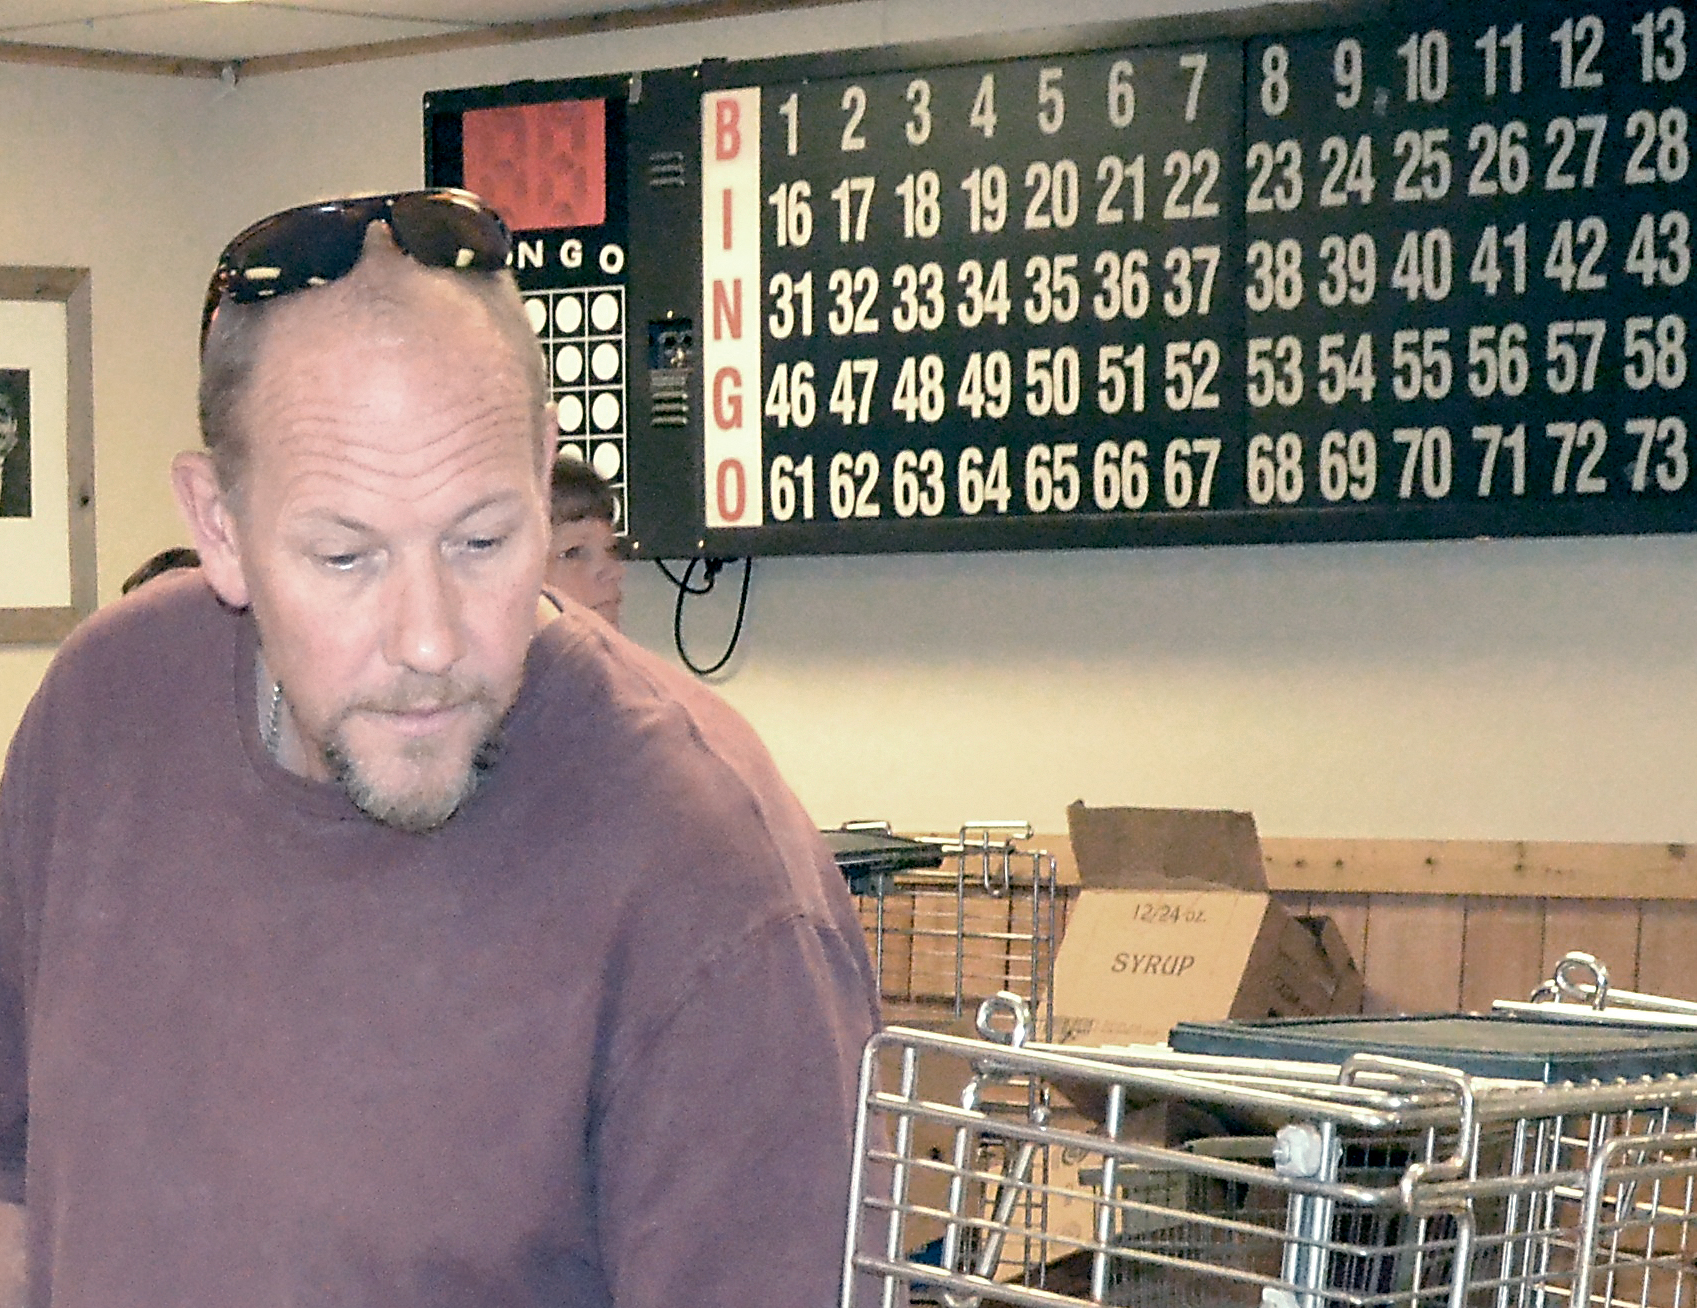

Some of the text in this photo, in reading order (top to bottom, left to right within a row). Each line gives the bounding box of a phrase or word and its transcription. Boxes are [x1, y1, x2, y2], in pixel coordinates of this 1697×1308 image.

[779, 7, 1687, 156] 1 2 3 4 5 6 7 8 9 10 11 12 13
[768, 106, 1689, 248] 16 17 18 19 20 21 22 23 24 25 26 27 28
[505, 239, 625, 275] NGO
[712, 98, 746, 521] BINGO
[768, 211, 1691, 340] 31 32 33 34 35 36 37 38 39 40 41 42 43
[764, 314, 1687, 429] 46 47 48 49 50 51 52 53 54 55 56 57 58
[769, 416, 1688, 522] 61 62 63 64 65 66 67 68 69 70 71 72 73
[1111, 953, 1195, 976] SYRUP
[1133, 904, 1181, 923] 12/24
